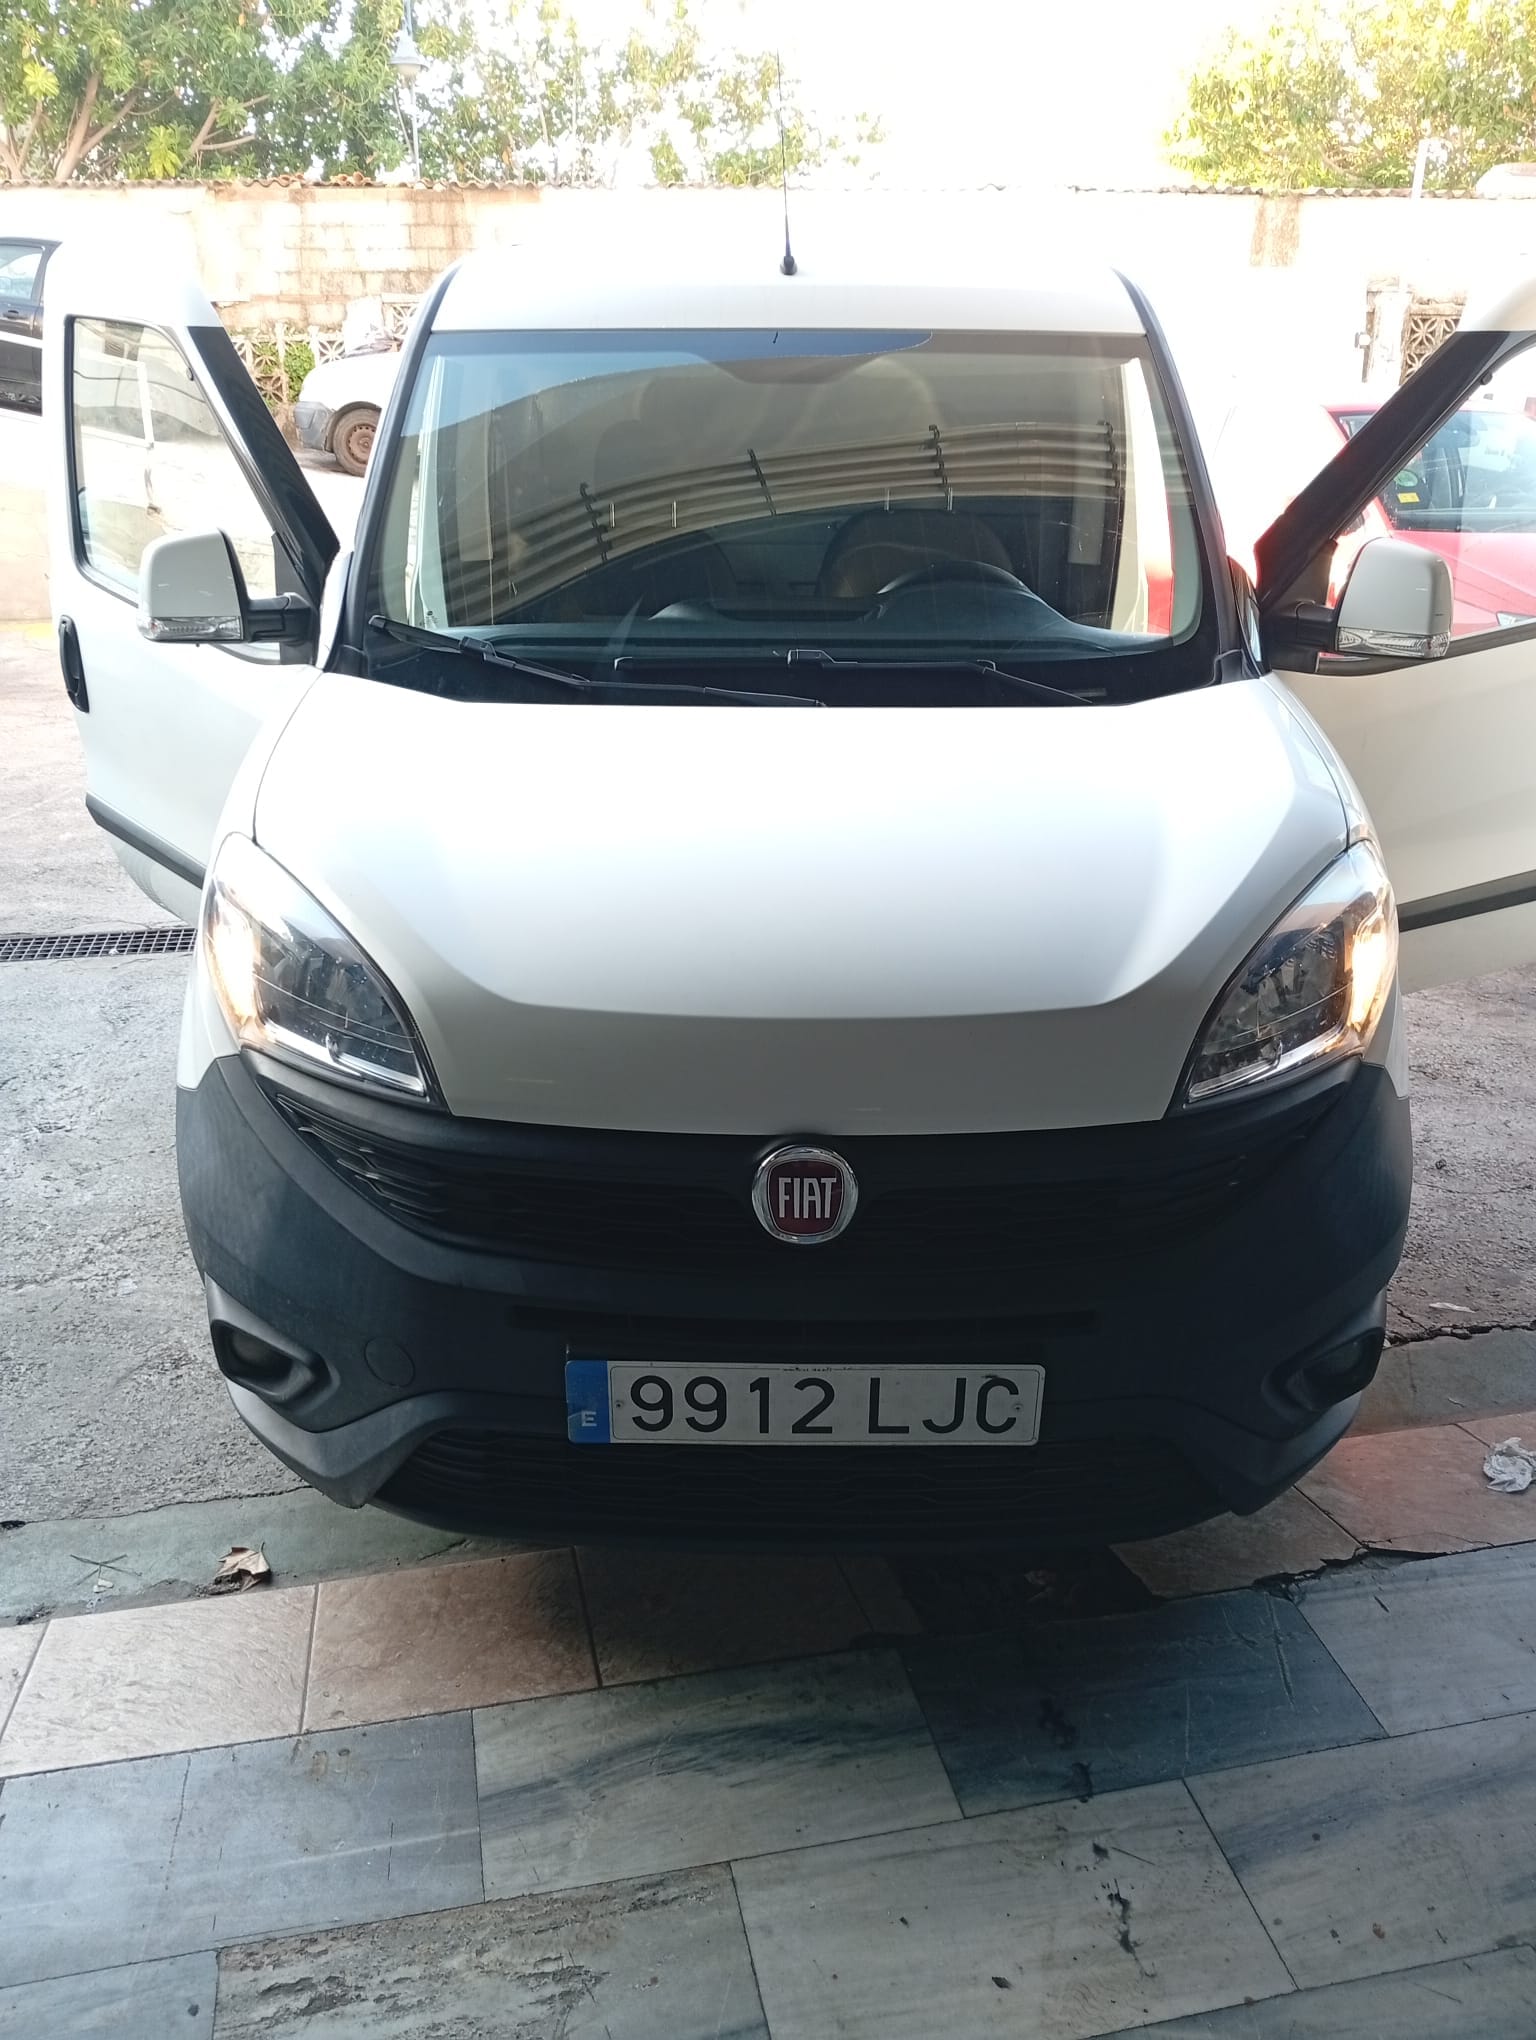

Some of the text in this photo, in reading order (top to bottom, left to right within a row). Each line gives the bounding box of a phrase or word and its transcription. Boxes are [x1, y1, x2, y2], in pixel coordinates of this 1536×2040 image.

[778, 1177, 837, 1219] FIAT
[581, 1410, 597, 1427] E
[630, 1375, 1019, 1434] 9912 LJC
